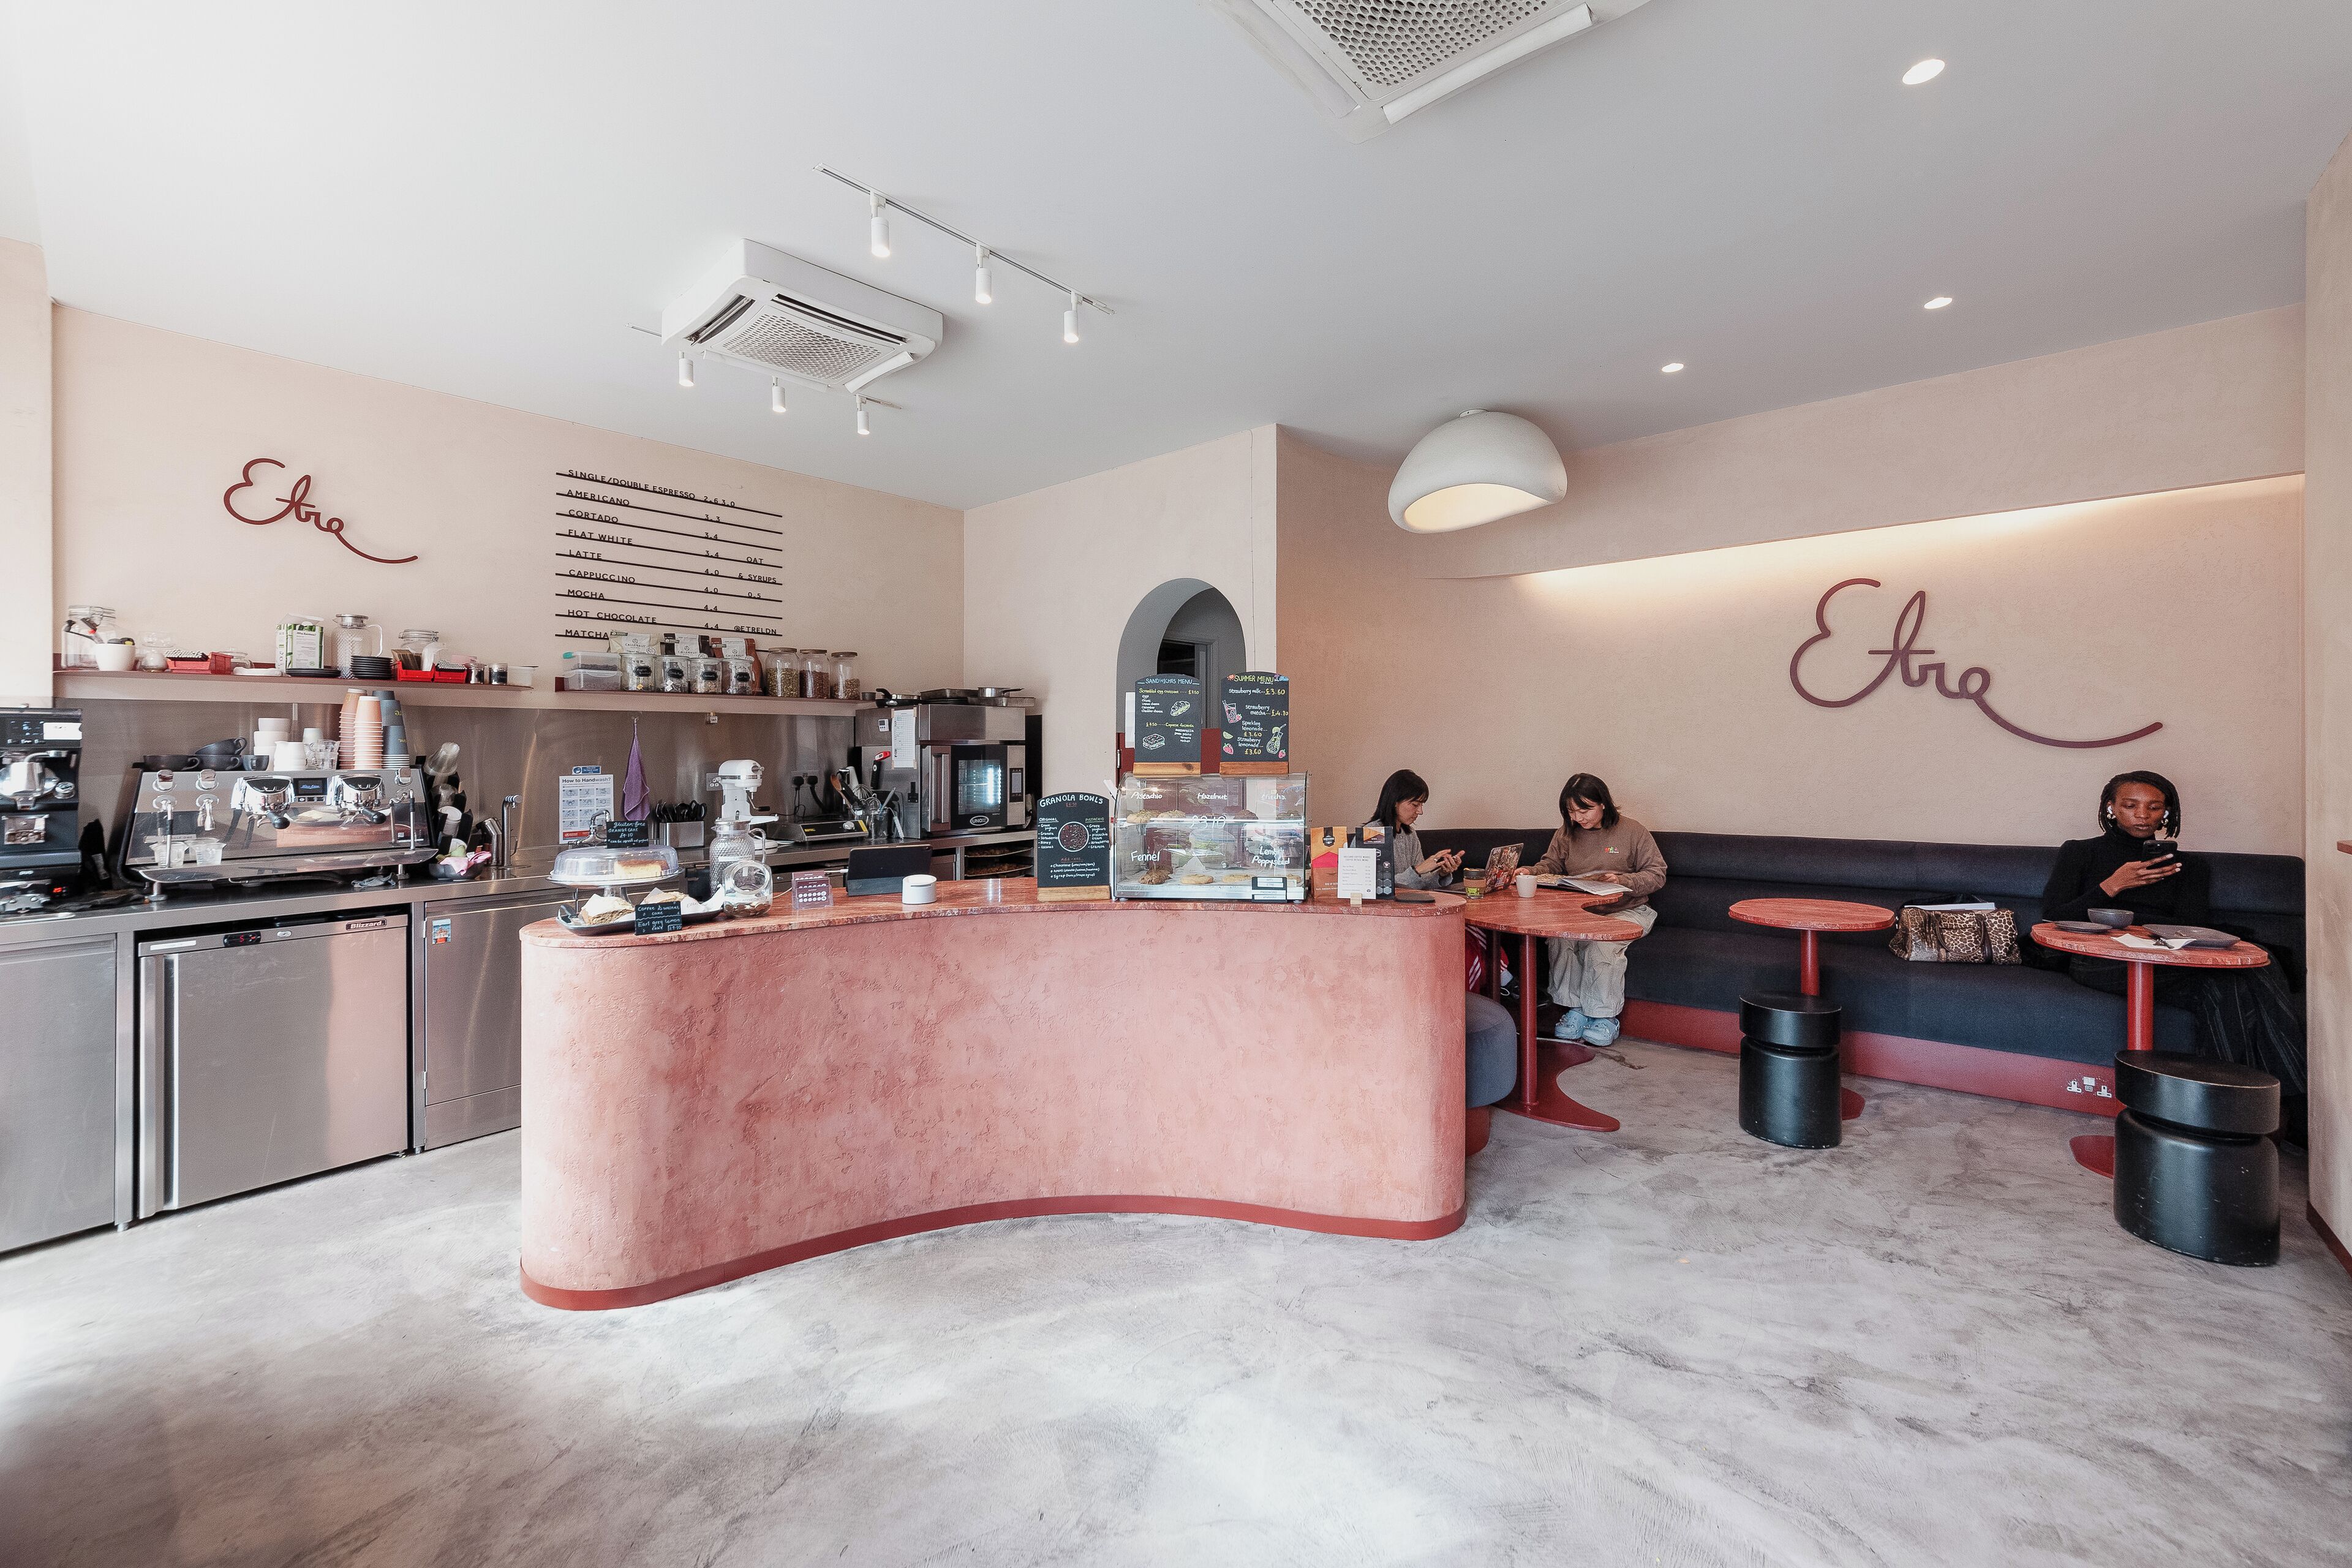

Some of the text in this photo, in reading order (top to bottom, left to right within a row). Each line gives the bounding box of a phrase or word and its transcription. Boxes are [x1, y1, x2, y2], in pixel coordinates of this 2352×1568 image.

[568, 469, 649, 491] SINGLE/DOUBLE
[653, 486, 695, 499] ESPRESSO
[567, 489, 630, 507] AMERICANO
[568, 509, 619, 523] CORTADO
[568, 529, 633, 545] FLAT WHITE
[569, 549, 602, 560] LATTE
[568, 569, 636, 584] CAPPUCCINO
[748, 574, 777, 583] SYRUPS
[567, 589, 605, 600] MOCHA
[597, 612, 657, 624] CHOCOLATE
[565, 629, 609, 639] MATCHA
[1039, 794, 1103, 807] GRANOLA BOWLS
[1131, 850, 1160, 862] Fennel
